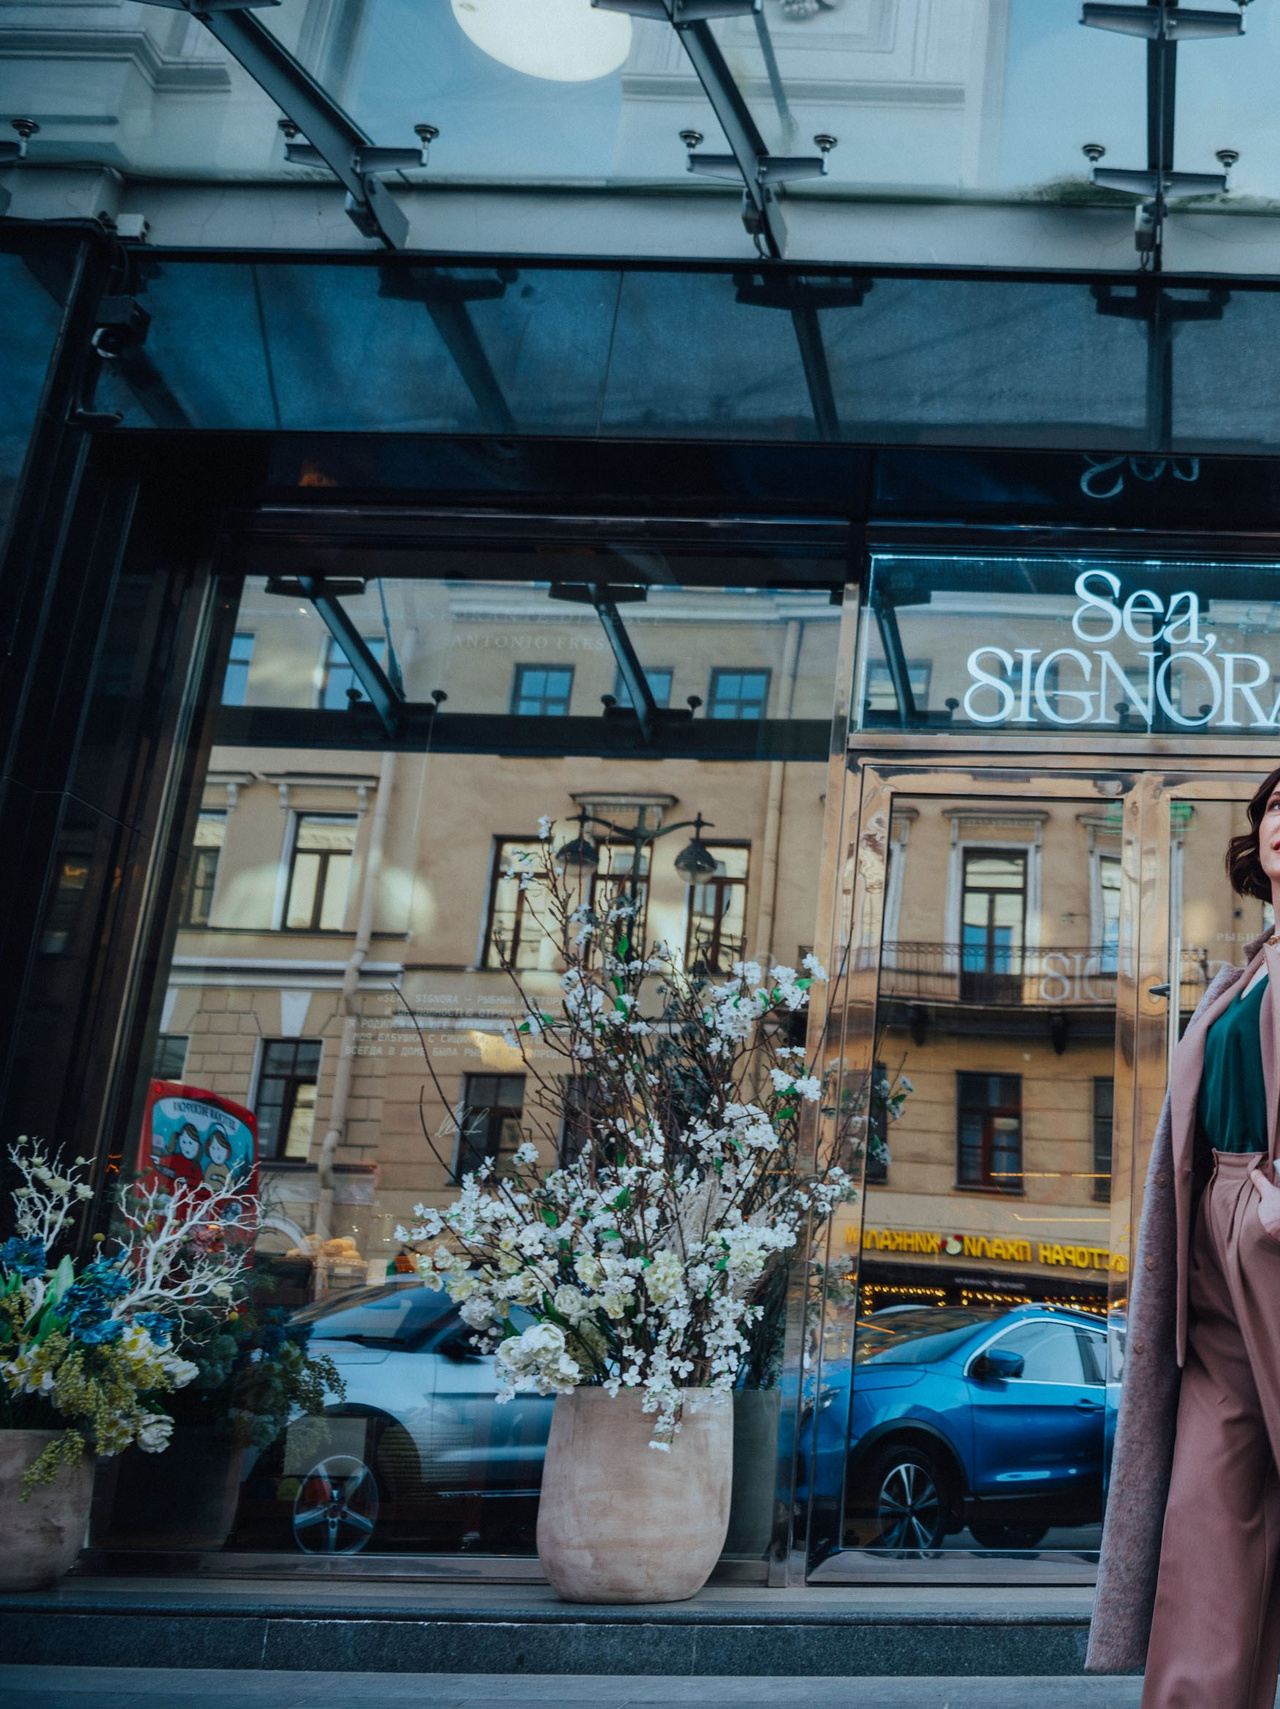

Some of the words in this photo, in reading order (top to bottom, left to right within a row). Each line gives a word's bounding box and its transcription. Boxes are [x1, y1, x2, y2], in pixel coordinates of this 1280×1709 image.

[1071, 569, 1218, 654] Sea,
[452, 634, 550, 650] ANTONIO
[555, 636, 606, 651] FRES
[1215, 932, 1261, 942] РЫБН
[415, 994, 459, 1004] SIGNORA
[433, 1048, 457, 1057] БЫЛА
